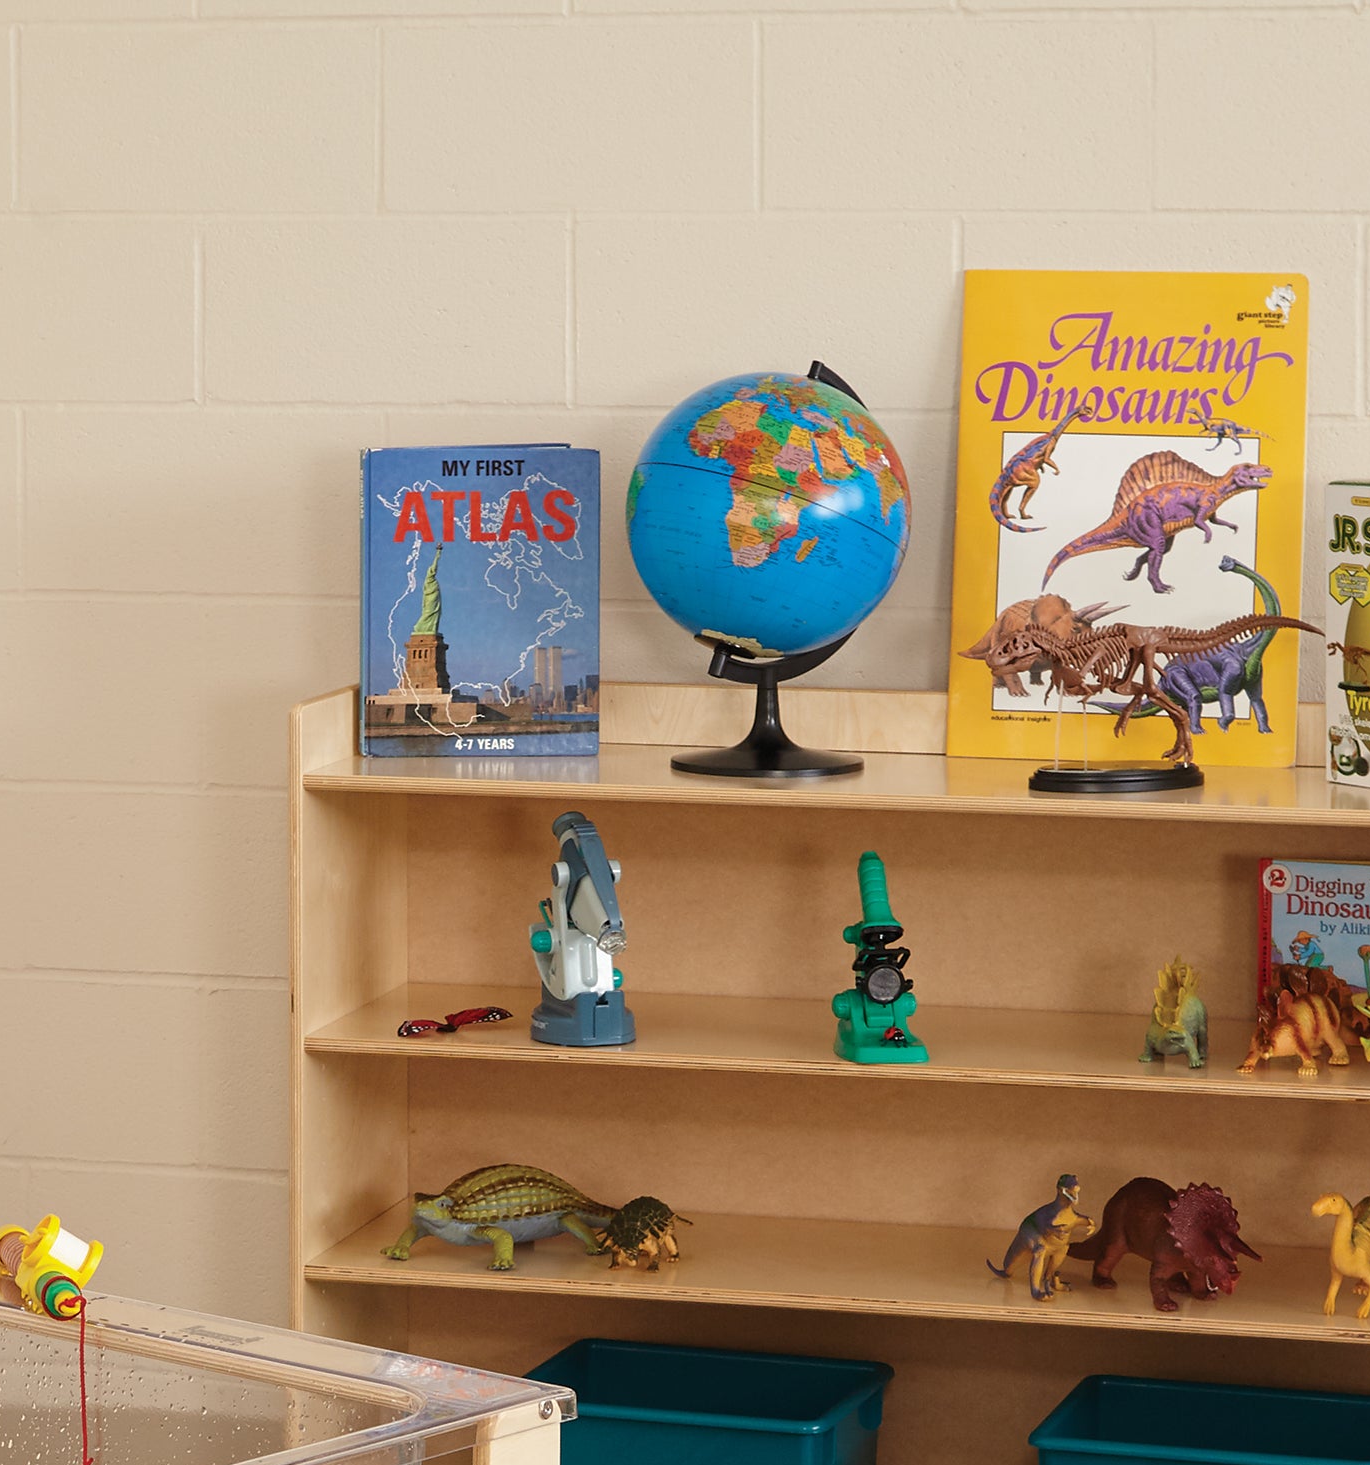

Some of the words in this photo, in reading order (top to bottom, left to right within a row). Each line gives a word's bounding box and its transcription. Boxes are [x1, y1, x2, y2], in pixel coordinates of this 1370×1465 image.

[1237, 311, 1262, 321] giant
[1038, 311, 1294, 406] Amazing
[975, 361, 1220, 424] Dinosaurs
[442, 460, 471, 476] MY
[476, 460, 525, 476] FIRST
[393, 490, 575, 542] ATLAS
[1329, 513, 1362, 554] JR.
[455, 738, 474, 750] 4-7
[478, 738, 515, 750] YEARS
[1270, 869, 1286, 887] 2
[1295, 875, 1365, 899] Digging
[1320, 921, 1334, 936] by
[1341, 922, 1370, 935] Aliki
